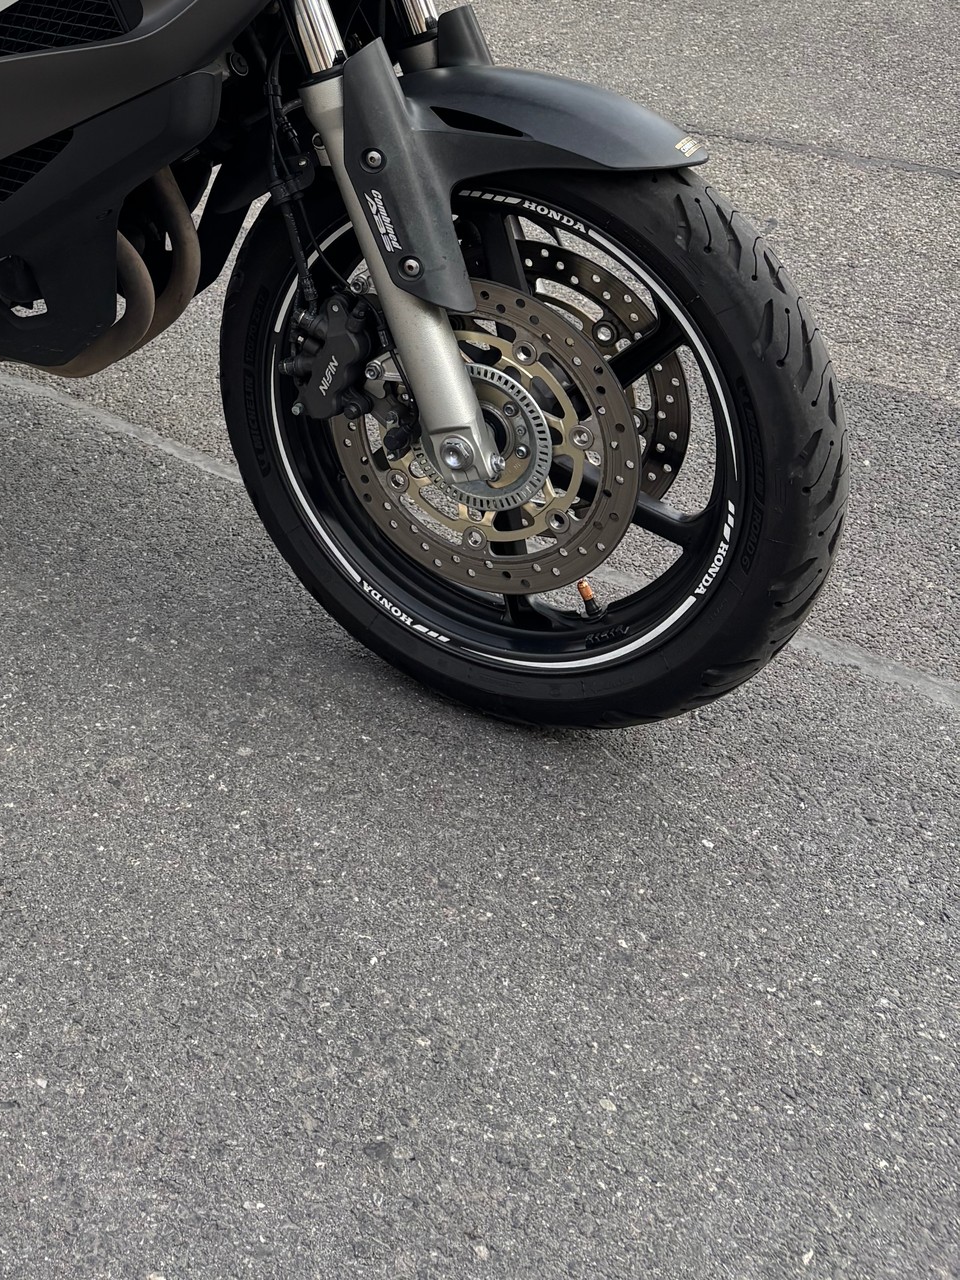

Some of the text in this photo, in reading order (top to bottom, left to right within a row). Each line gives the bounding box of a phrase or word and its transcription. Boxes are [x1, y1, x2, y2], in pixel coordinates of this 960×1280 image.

[363, 192, 395, 253] ABS
[371, 189, 403, 250] Combined
[522, 199, 587, 234] HONDA
[694, 540, 730, 595] HONDA
[362, 580, 414, 626] HONDA
